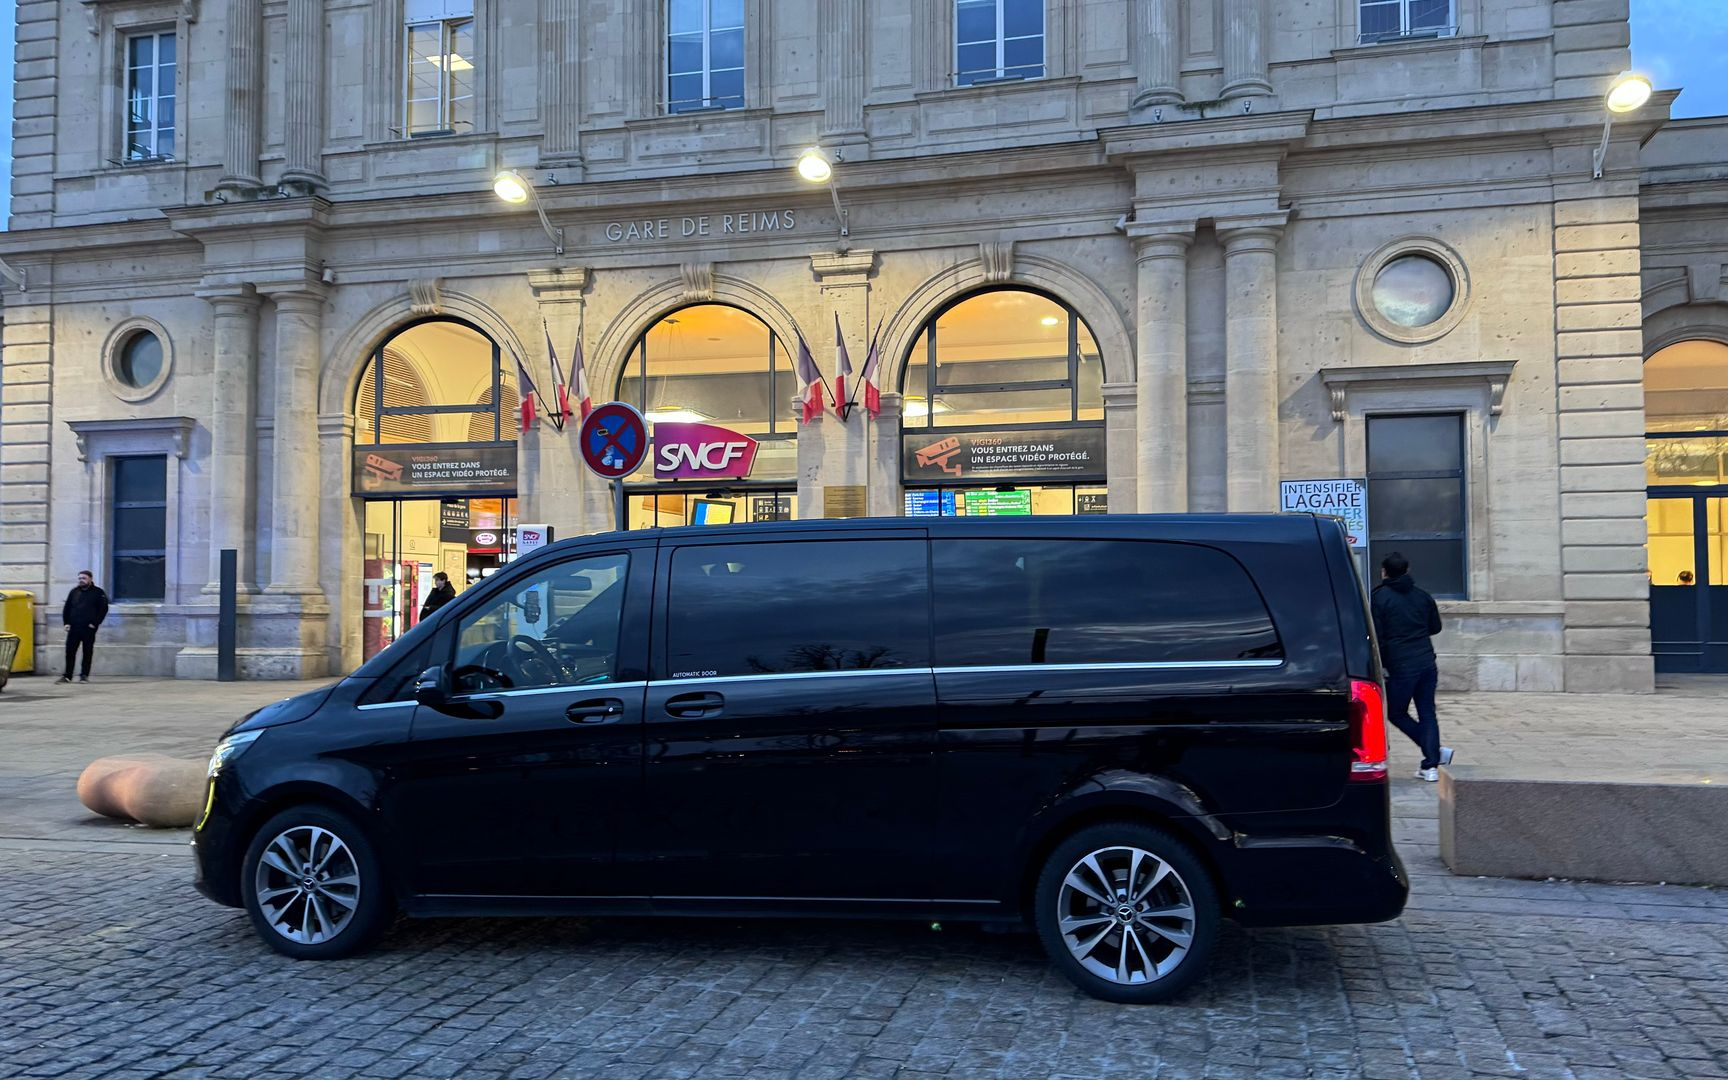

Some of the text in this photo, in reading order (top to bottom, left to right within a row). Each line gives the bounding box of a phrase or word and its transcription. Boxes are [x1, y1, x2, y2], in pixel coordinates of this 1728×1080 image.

[606, 210, 796, 241] GARE DE REIMS
[971, 438, 1002, 446] VIGI360
[971, 444, 1054, 454] VOUS ENTREZ DANS
[656, 441, 748, 472] SNCF
[986, 455, 1018, 463] ESPACE
[1020, 452, 1046, 461] VIDÉO
[1048, 450, 1090, 460] PROTÉGÉ.
[424, 470, 450, 478] ESPACE
[451, 469, 474, 477] VIDÉO
[475, 468, 510, 476] PROTÉGÉ.
[1284, 483, 1362, 494] INTENSIFIER
[1285, 493, 1361, 508] LAGARE
